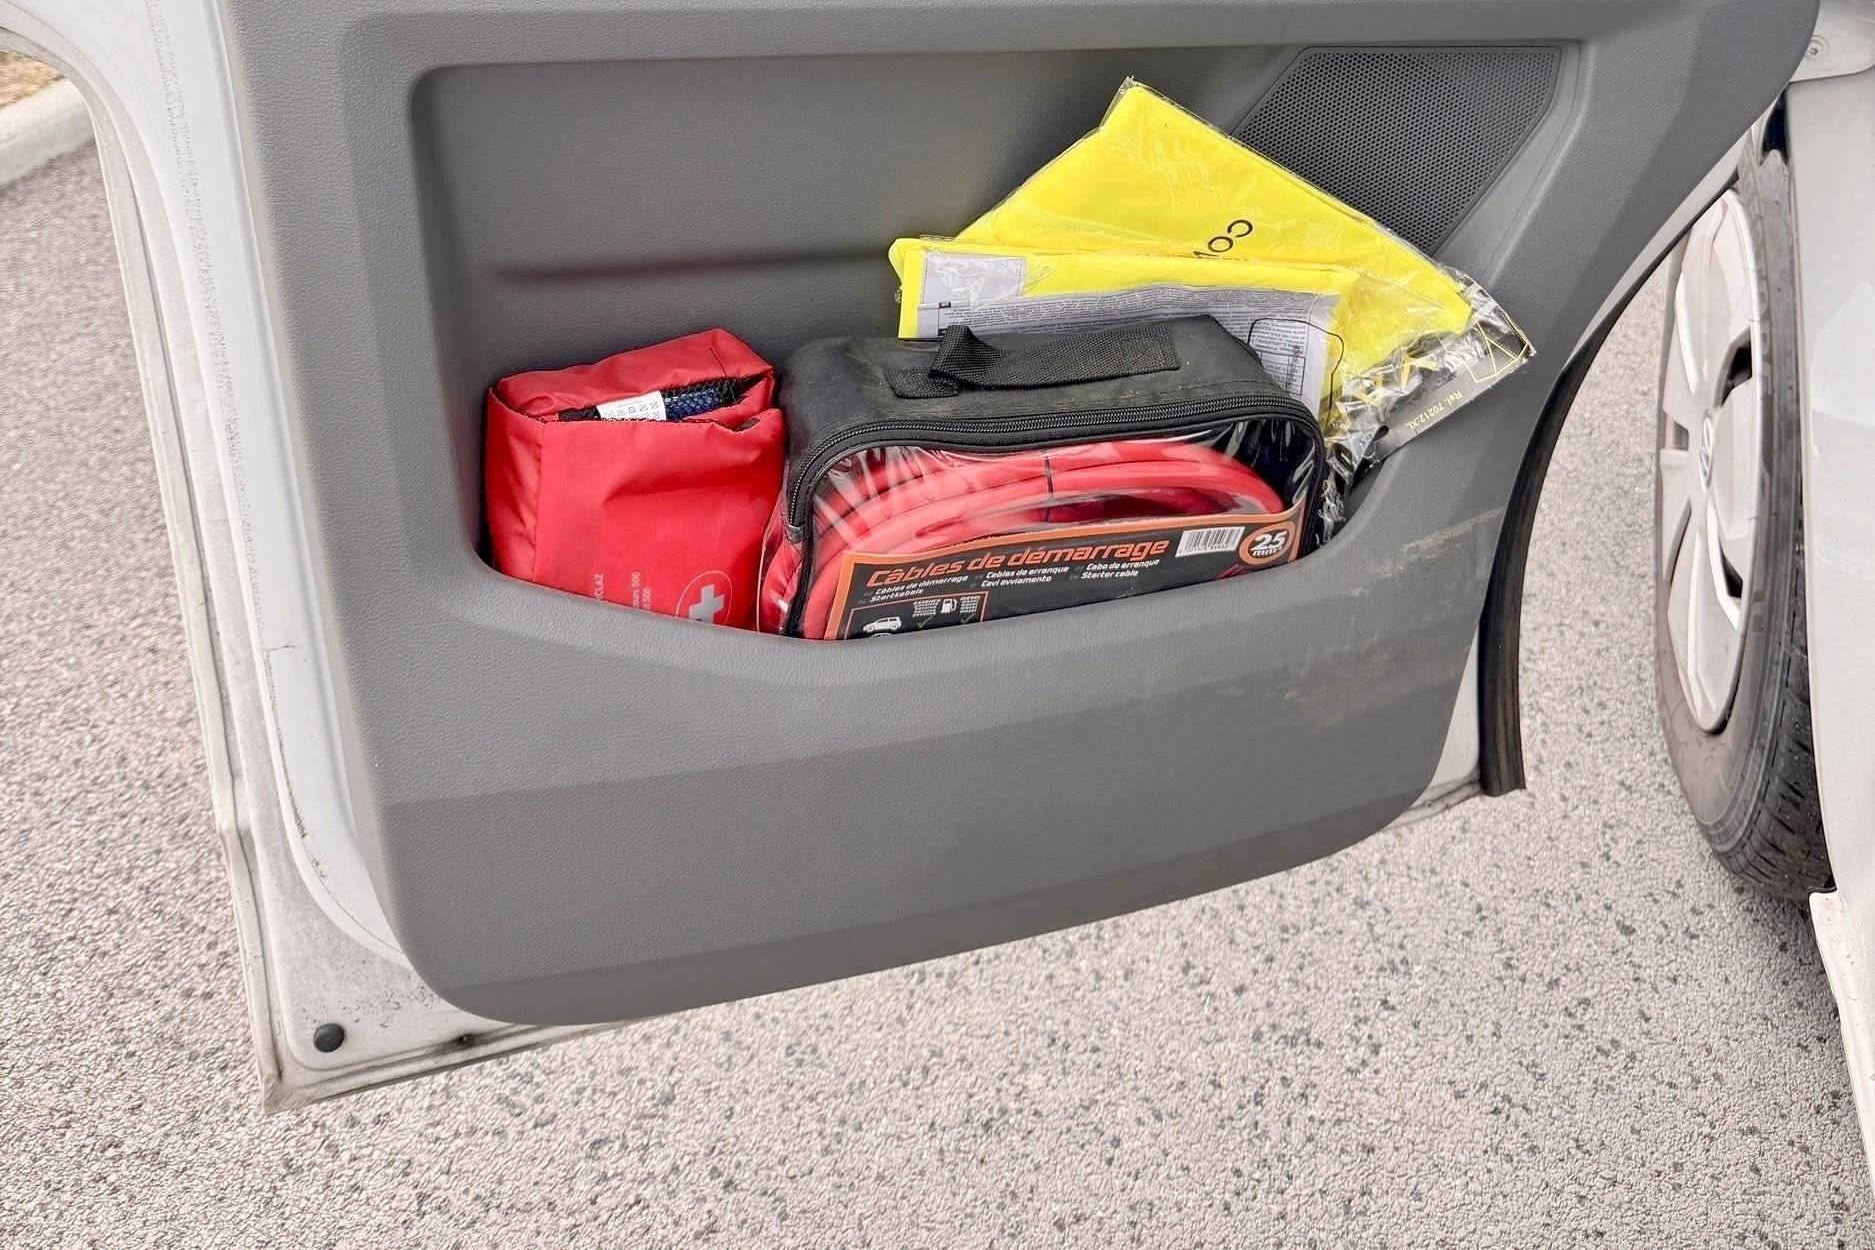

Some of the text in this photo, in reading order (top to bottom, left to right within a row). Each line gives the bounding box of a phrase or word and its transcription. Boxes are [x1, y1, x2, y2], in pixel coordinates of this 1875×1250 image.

[1250, 529, 1288, 550] 25
[867, 560, 966, 588] Câbles
[967, 552, 1006, 571] de
[1007, 540, 1170, 567] démarrage
[1016, 567, 1028, 576] de
[1029, 565, 1069, 575] arranque
[1086, 562, 1108, 571] Cabo
[1109, 561, 1121, 570] de
[1122, 558, 1160, 570] arranque
[1002, 575, 1052, 586] avviamento
[1080, 570, 1114, 579] Starter
[1115, 569, 1139, 578] cable
[875, 584, 905, 595] Câbles
[906, 583, 917, 591] de
[918, 575, 969, 588] démarrage
